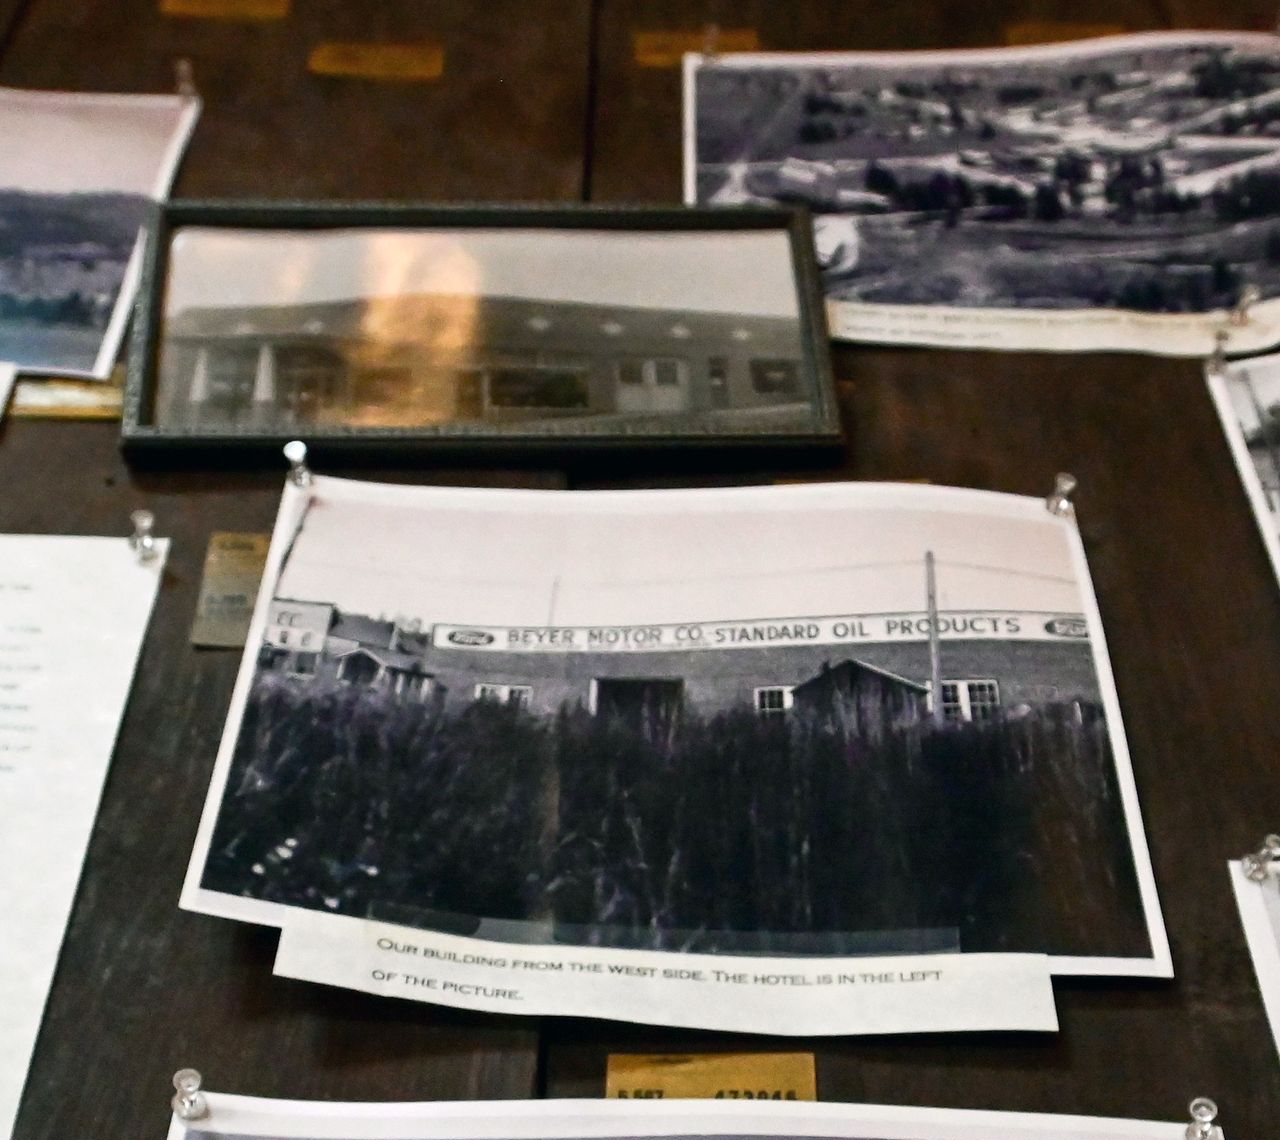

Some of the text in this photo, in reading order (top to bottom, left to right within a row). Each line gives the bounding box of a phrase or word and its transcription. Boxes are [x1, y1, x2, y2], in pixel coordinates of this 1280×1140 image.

[508, 628, 574, 645] BEYER
[588, 627, 662, 645] MOTOR
[714, 621, 820, 643] STANDARD
[833, 619, 871, 638] OIL
[885, 617, 1021, 636] PRODUCTS
[376, 937, 419, 956] OUR
[422, 947, 508, 969] BUILDING
[511, 958, 564, 971] FROM
[569, 961, 603, 974] THE
[607, 964, 658, 978] WEST
[711, 969, 748, 985] THE
[752, 974, 812, 987] HOTEL
[816, 974, 834, 985] IS
[837, 974, 856, 985] IN
[859, 972, 894, 984] THE
[899, 970, 943, 983] LEFT
[371, 969, 524, 1000] OF THE PICTURE.
